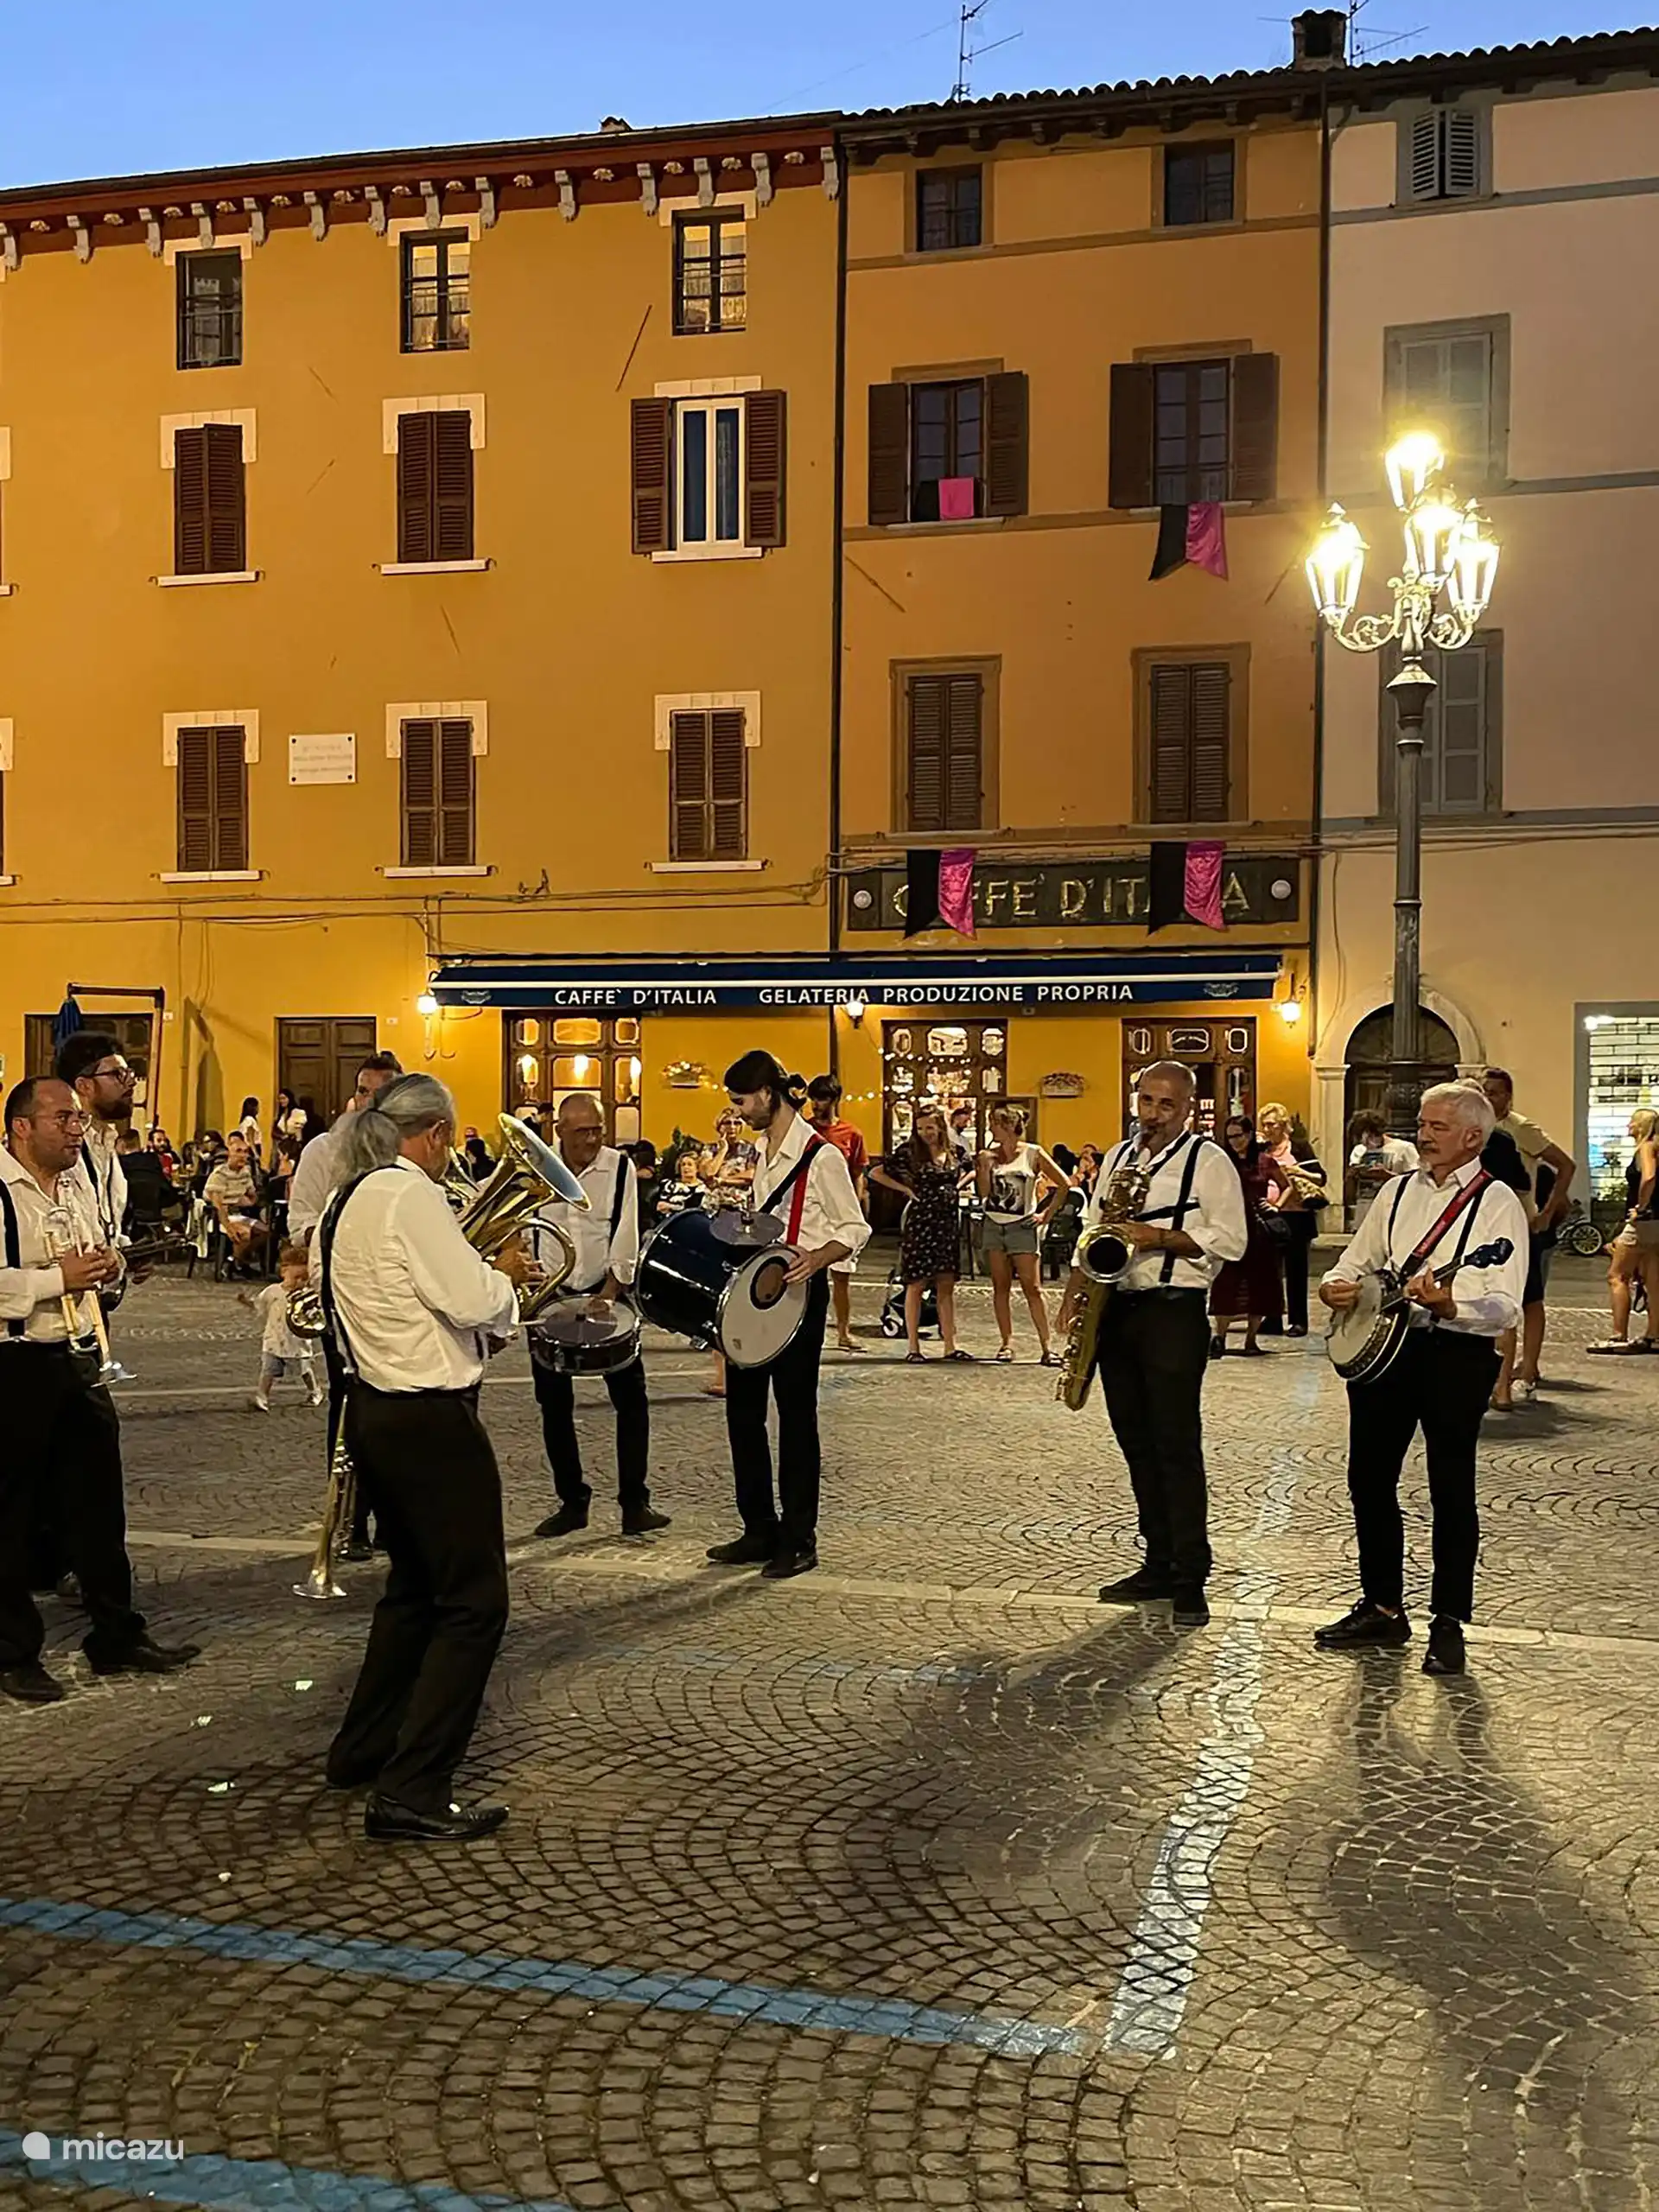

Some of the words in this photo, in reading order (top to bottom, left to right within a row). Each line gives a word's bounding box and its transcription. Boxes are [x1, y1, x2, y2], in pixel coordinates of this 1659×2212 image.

[1060, 871, 1250, 918] D'ITA
[632, 988, 717, 1005] D'ITALIA
[759, 988, 870, 1004] GELATERIA
[882, 986, 1024, 1003] PRODUZIONE
[1037, 984, 1134, 1001] PROPRIA
